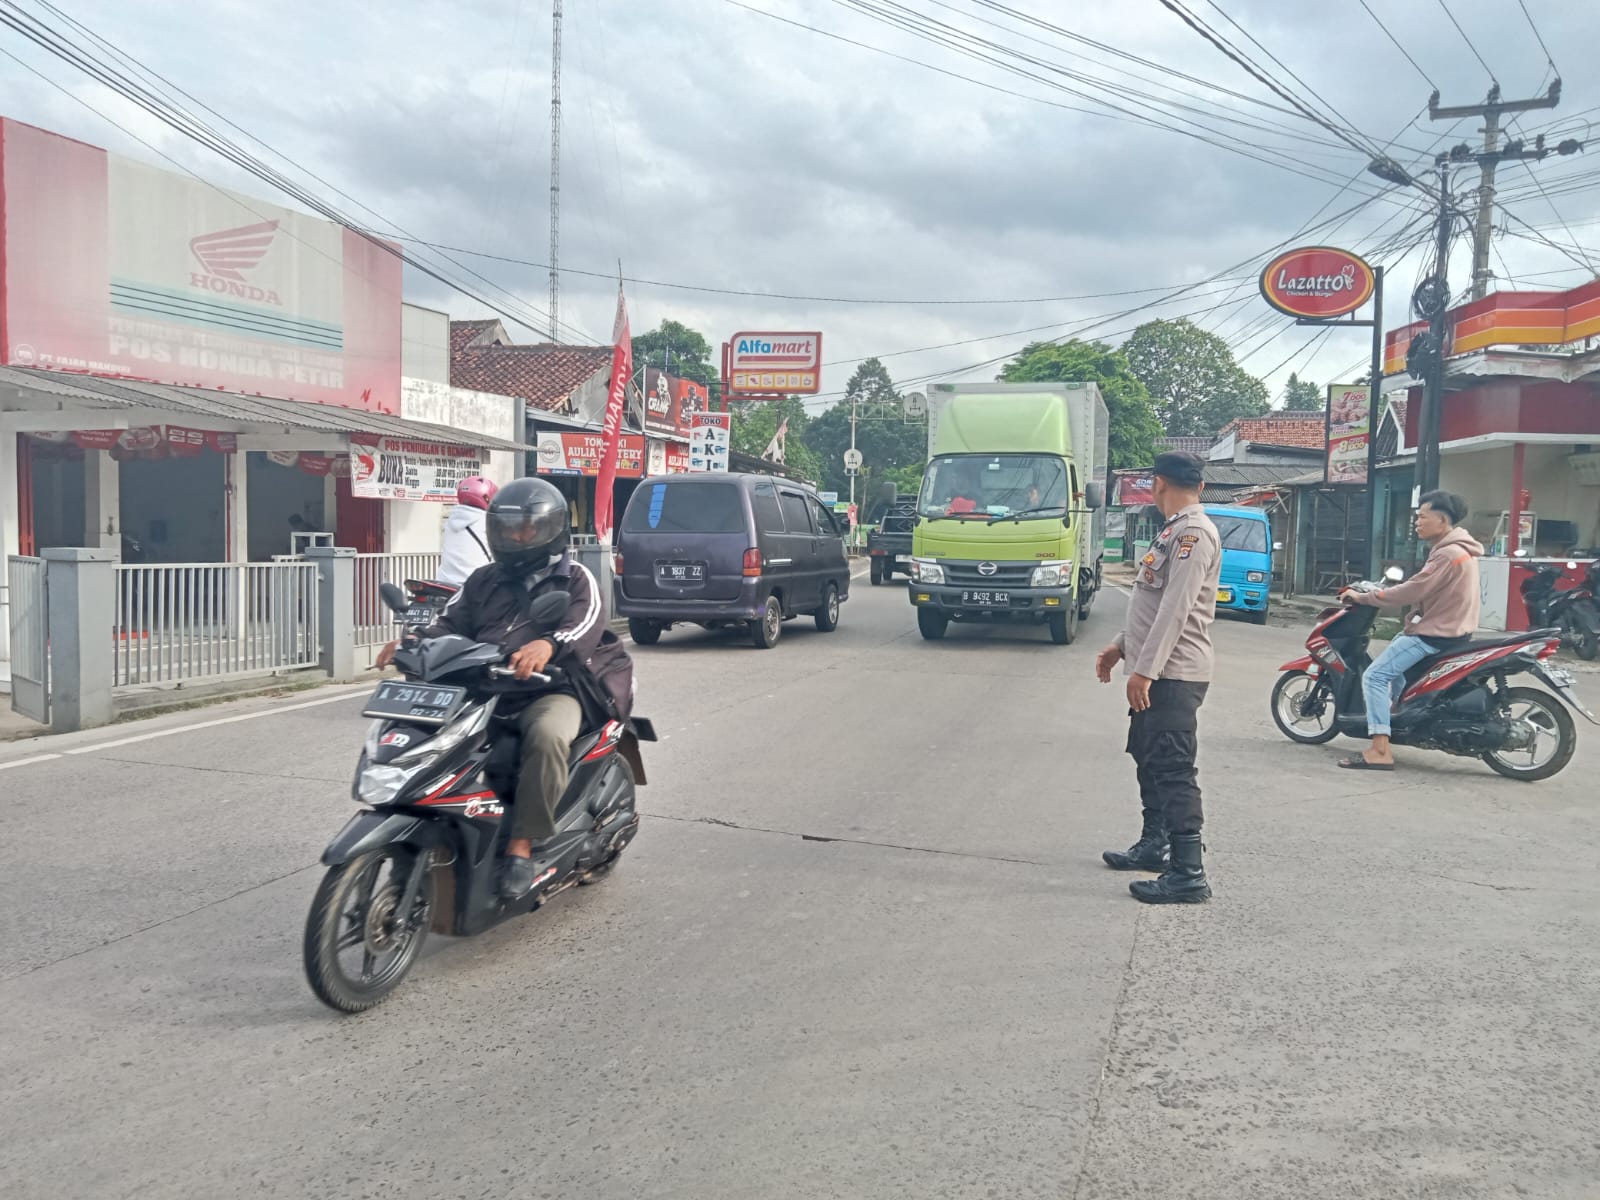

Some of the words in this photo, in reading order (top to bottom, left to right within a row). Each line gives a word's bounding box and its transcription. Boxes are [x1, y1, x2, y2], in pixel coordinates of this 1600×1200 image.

[1278, 269, 1344, 290] Lazatto
[190, 271, 283, 305] HONDA
[738, 339, 811, 354] Alfamart
[109, 335, 172, 363] POS
[179, 346, 273, 380] HONDA
[279, 360, 344, 390] PETIR
[700, 417, 721, 425] TOKO
[384, 440, 400, 452] POS
[568, 447, 597, 457] AULIA
[378, 454, 403, 485] BUKA
[380, 687, 391, 700] A
